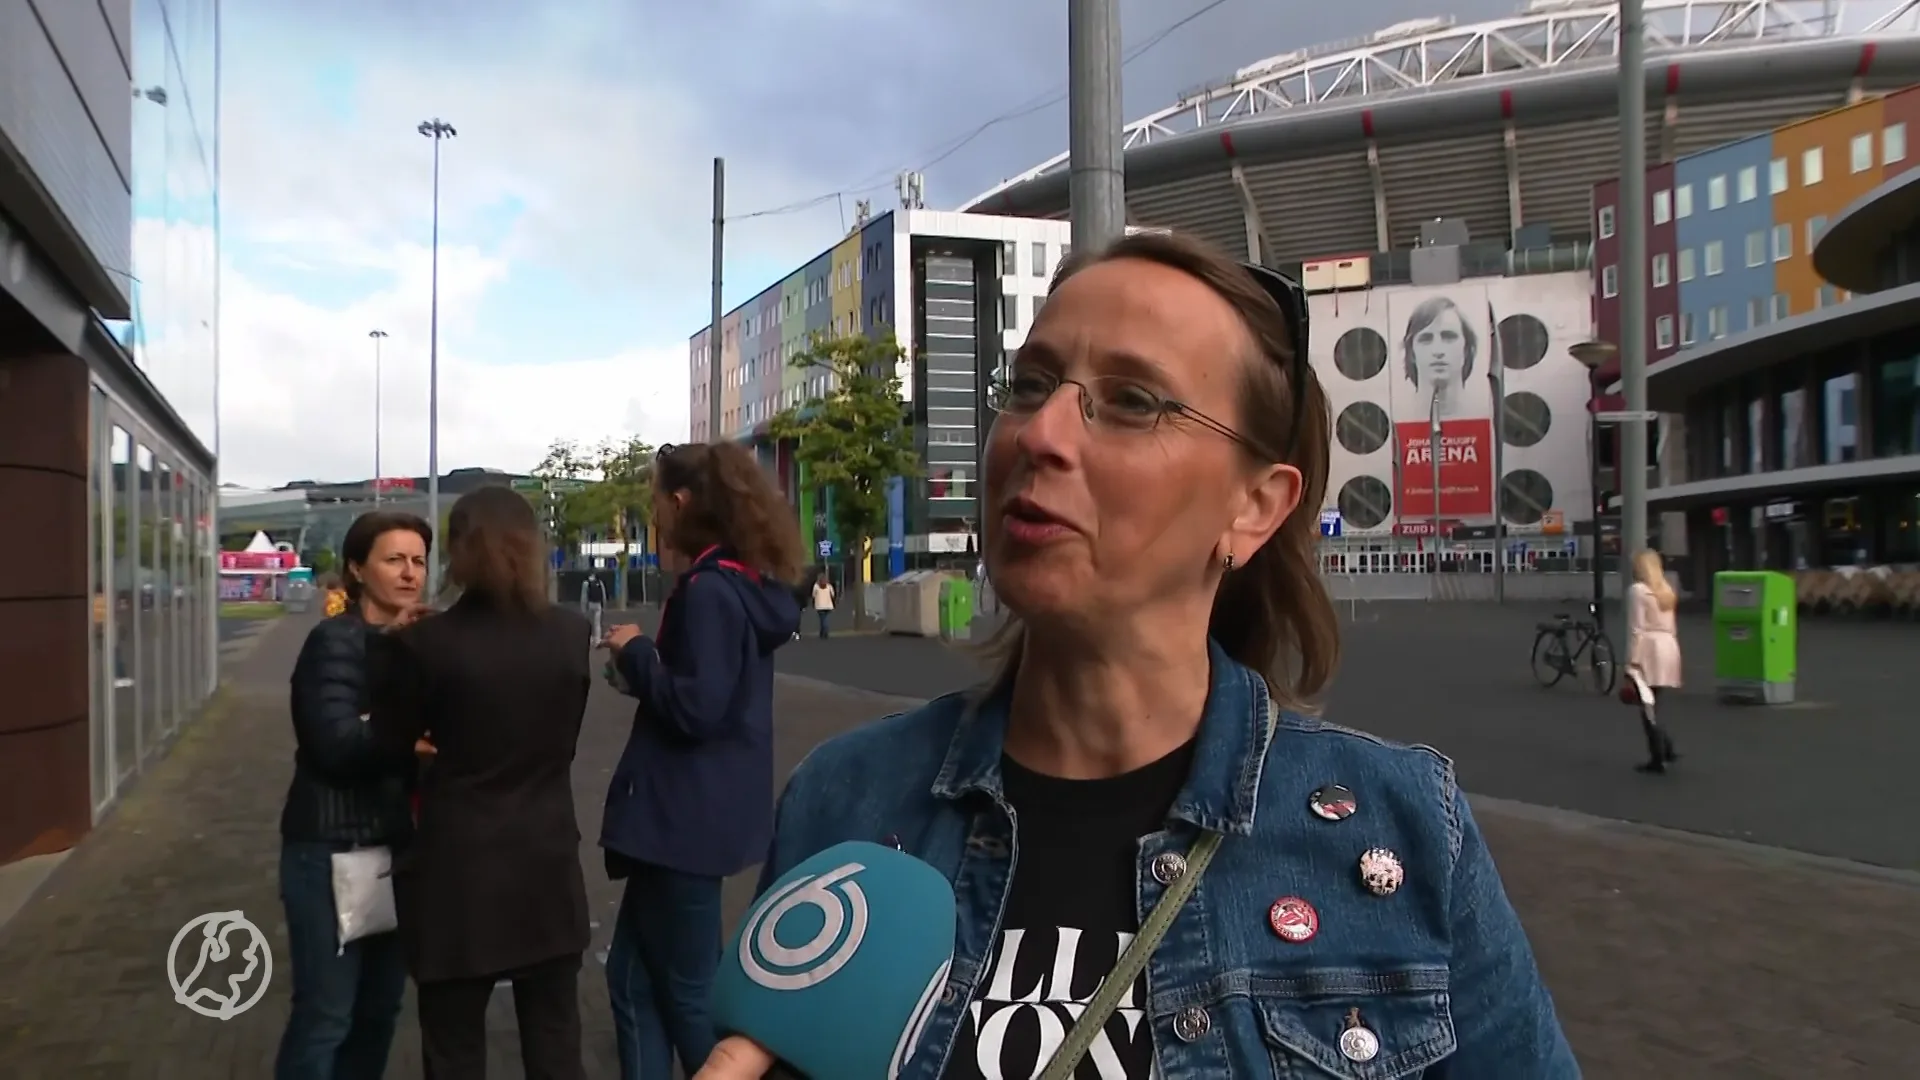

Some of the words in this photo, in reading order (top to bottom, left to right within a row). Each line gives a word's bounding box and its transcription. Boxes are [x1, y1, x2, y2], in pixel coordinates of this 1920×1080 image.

[1406, 438, 1432, 448] JOHA
[1406, 446, 1478, 465] ARENA
[1402, 525, 1428, 534] ZUID
